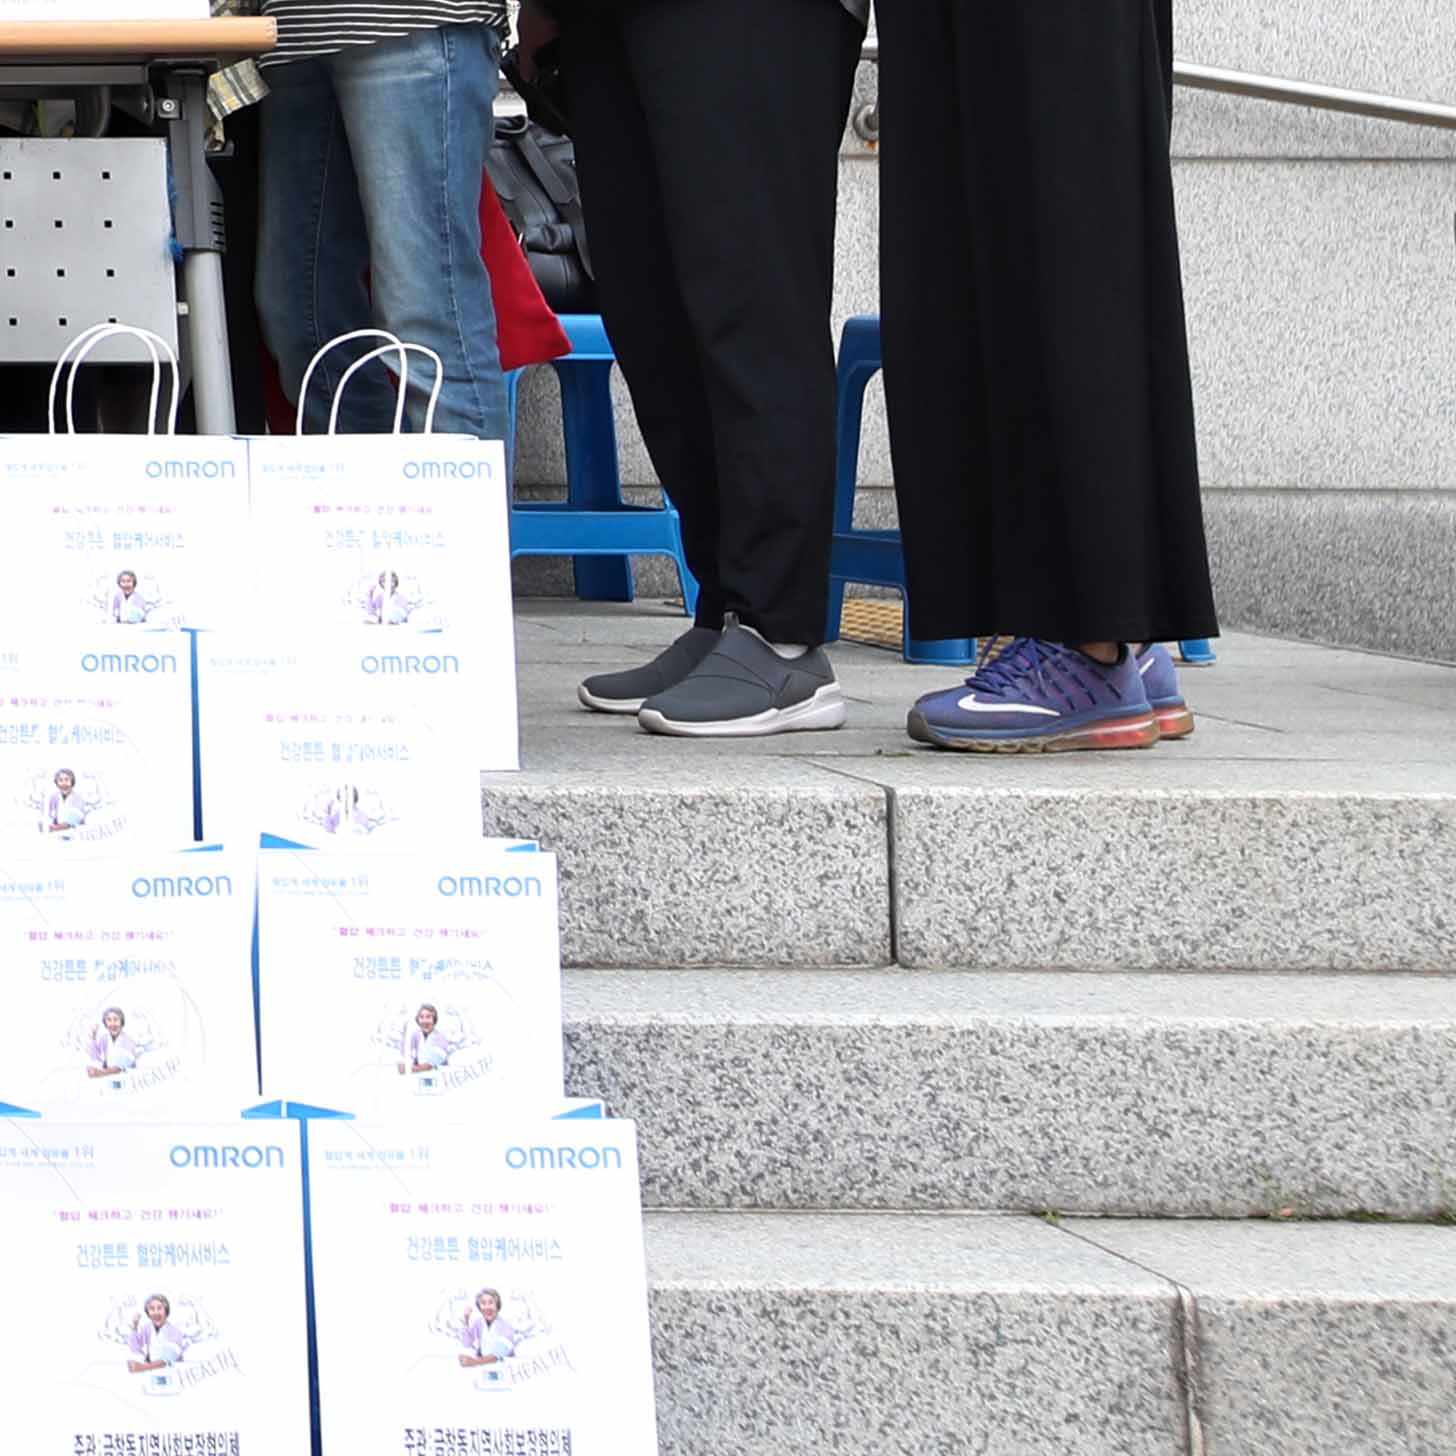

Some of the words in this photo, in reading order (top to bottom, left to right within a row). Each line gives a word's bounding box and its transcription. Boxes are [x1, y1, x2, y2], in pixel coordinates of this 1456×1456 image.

[145, 459, 236, 479] OMRON
[402, 460, 492, 480] OMRON
[80, 652, 177, 674] OMRON
[360, 655, 460, 675] OMRON
[130, 874, 233, 899] OMRON
[436, 875, 542, 898] OMRON
[168, 1144, 285, 1169] OMRON
[504, 1145, 623, 1170] OMRON
[76, 1241, 129, 1270] 건강튼튼
[135, 1241, 231, 1268] 혈압케어서비스
[407, 1232, 462, 1262] 건강튼튼
[467, 1235, 563, 1263] 혈압케어서비스
